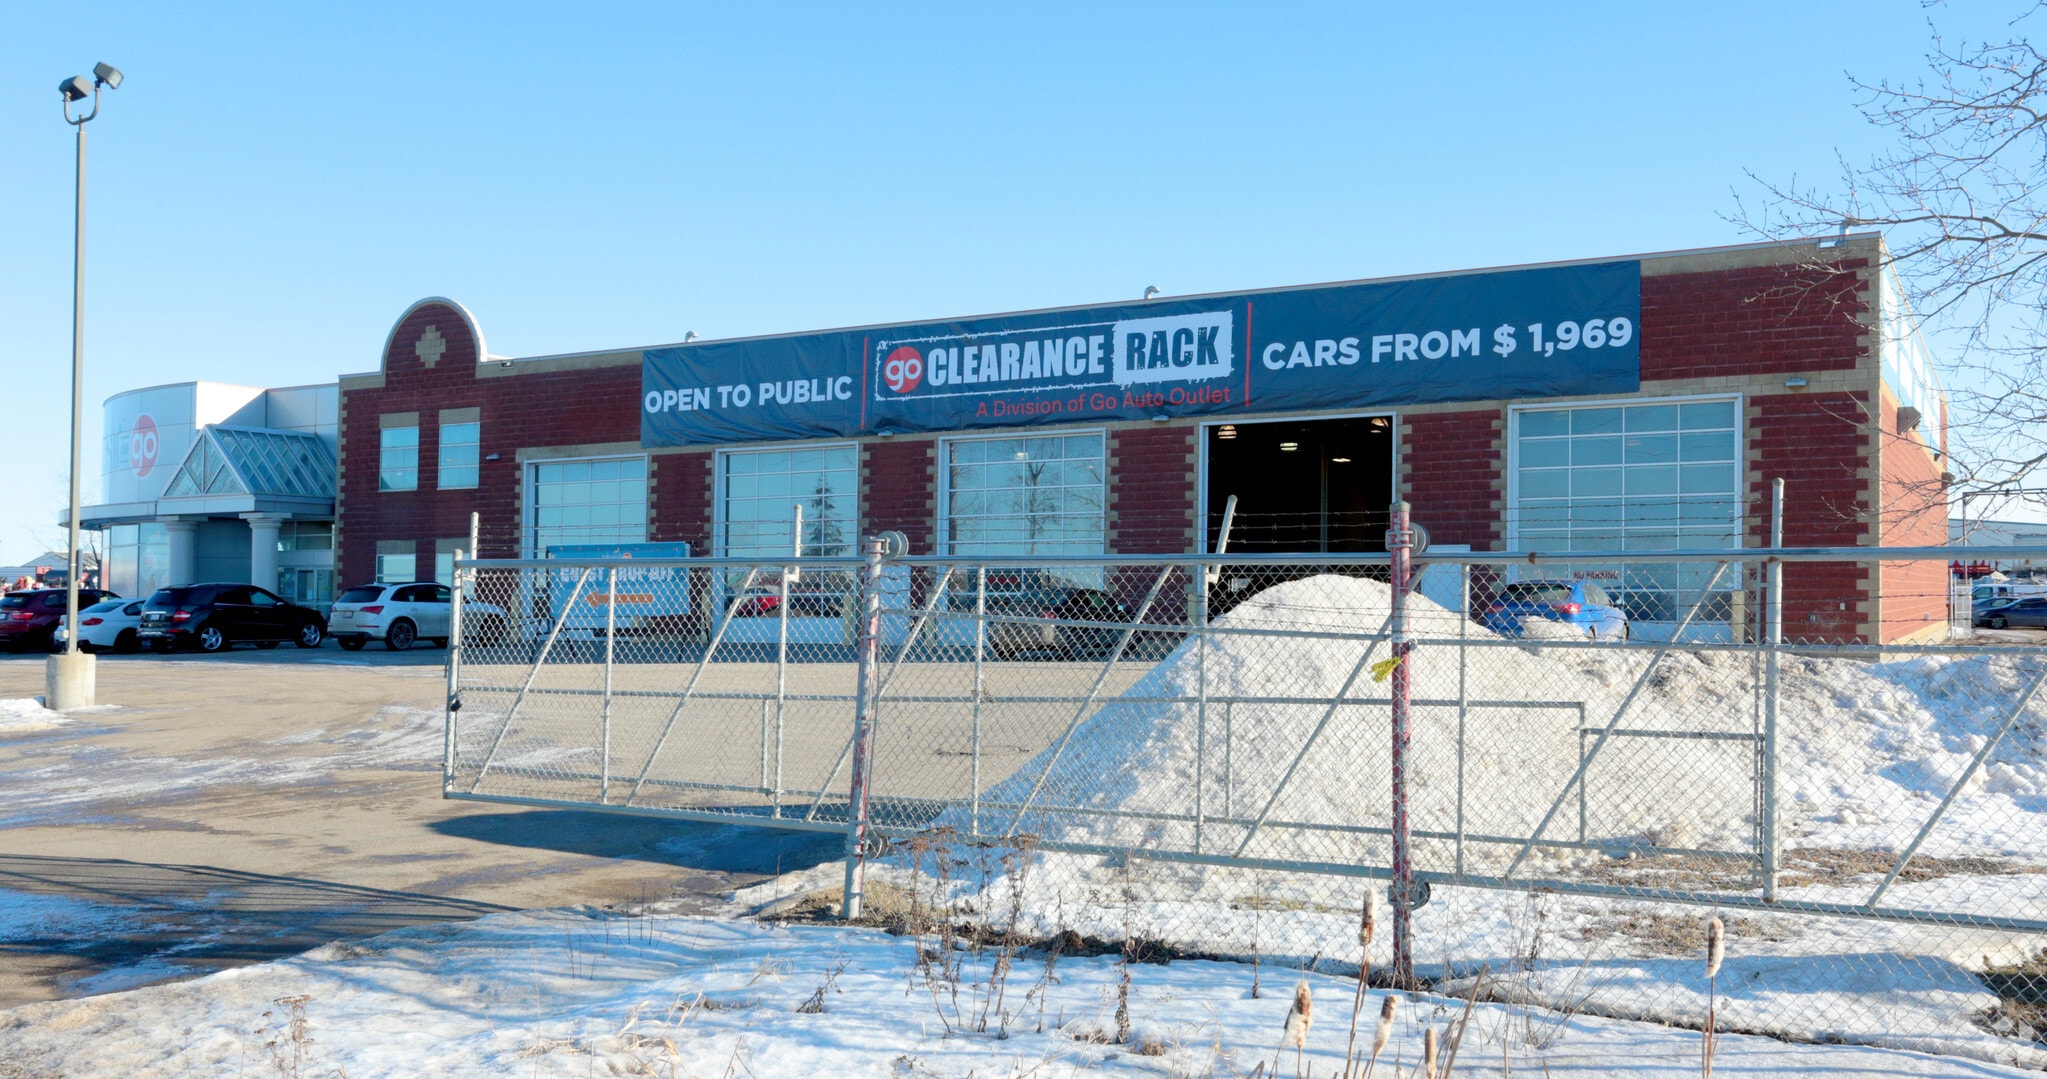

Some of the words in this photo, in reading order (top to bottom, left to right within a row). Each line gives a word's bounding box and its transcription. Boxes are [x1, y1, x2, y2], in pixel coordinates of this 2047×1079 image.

[885, 357, 922, 391] go
[927, 334, 1104, 386] CLEARANCE
[1126, 325, 1220, 371] RACK
[1262, 337, 1360, 370] CARS
[1371, 328, 1480, 363] FROM
[1492, 324, 1516, 358] $
[1527, 316, 1633, 358] 1,969
[644, 387, 710, 413] OPEN
[717, 384, 751, 408] TO
[759, 375, 852, 406] PUBLIC
[976, 402, 988, 418] A
[993, 397, 1062, 417] Division
[1067, 393, 1086, 412] of
[1089, 393, 1117, 410] Go
[1122, 391, 1164, 409] Auto
[1169, 386, 1231, 405] Outlet
[131, 431, 157, 475] go
